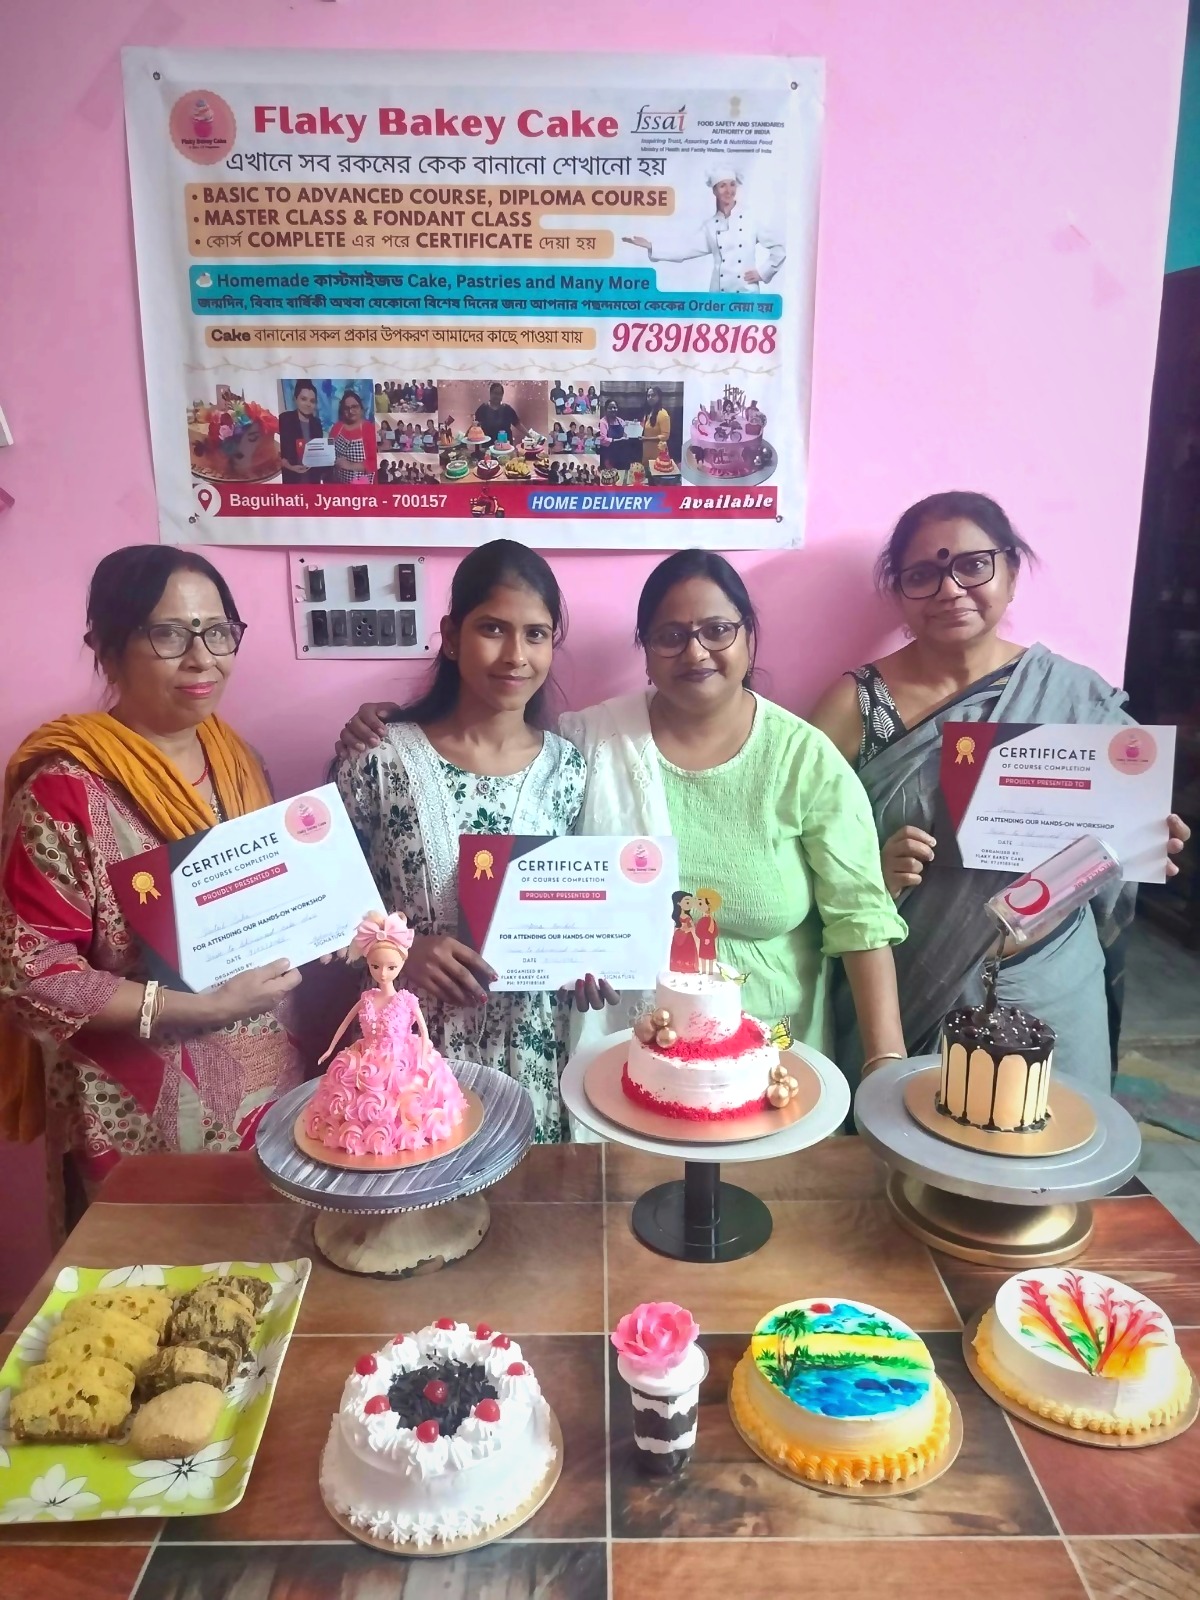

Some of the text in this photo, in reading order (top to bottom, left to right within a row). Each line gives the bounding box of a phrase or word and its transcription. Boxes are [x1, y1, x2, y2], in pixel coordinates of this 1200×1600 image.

[254, 105, 619, 145] Flaky Bakey Cake
[635, 104, 687, 133] fssai
[715, 120, 736, 128] SAFETY
[737, 120, 750, 129] AND
[750, 121, 785, 129] STANDARDS
[745, 128, 752, 136] OF
[226, 152, 667, 176] এখানে সব রকমের কেক বানানো শেখানো হয়
[203, 187, 668, 207] BASIC TO ADVANCED COURSE, DIPLOMA COURSE
[205, 210, 532, 228] MASTER CLASS & FONDANT CLASS
[206, 231, 597, 250] কোর্স COMPLETE এর পরে CERTIFICATE দেয়া হয়
[217, 274, 309, 288] Homemade
[407, 273, 452, 290] Cake,
[456, 274, 522, 288] Pastries
[525, 275, 555, 289] and
[560, 275, 604, 293] Many
[609, 276, 650, 290] More
[250, 295, 283, 308] বিবাহ
[286, 294, 327, 308] বার্ষিকী
[330, 297, 365, 308] অথবা
[368, 297, 421, 309] যেকোনো
[424, 295, 460, 309] বিশেষ
[464, 295, 498, 310] দিনের
[502, 299, 527, 310] জন্য
[530, 299, 578, 310] আপনার
[644, 300, 685, 311] কেকের
[689, 299, 726, 312] Order
[757, 302, 773, 313] হয়
[211, 325, 583, 345] Cake বানানোর সকল প্রকার উপকরণ আমাদের কাছে পাওয়া যায়
[612, 322, 777, 354] 9739188168
[229, 493, 310, 510] Baguihati,
[314, 494, 378, 511] Jyangra
[392, 494, 448, 508] 700157
[532, 493, 774, 511] HOME DELIVERY Available
[999, 747, 1096, 760] CERTIFICATE
[990, 817, 1024, 825] ATTENDING
[182, 832, 279, 877] CERTIFICATE
[191, 851, 279, 888] OF COURSE COMPLETION
[518, 860, 609, 871] CERTIFICATE
[202, 867, 281, 901] PROUDLY PRESENTED TO
[192, 942, 206, 952] FOR
[208, 928, 242, 946] ATTENDING
[242, 921, 257, 932] OUR
[257, 909, 290, 925] HANDS-ON
[291, 894, 327, 912] WORKSHOP
[313, 931, 345, 947] SIGNATURE
[225, 954, 242, 964] DATE
[213, 966, 243, 981] ORGANISED
